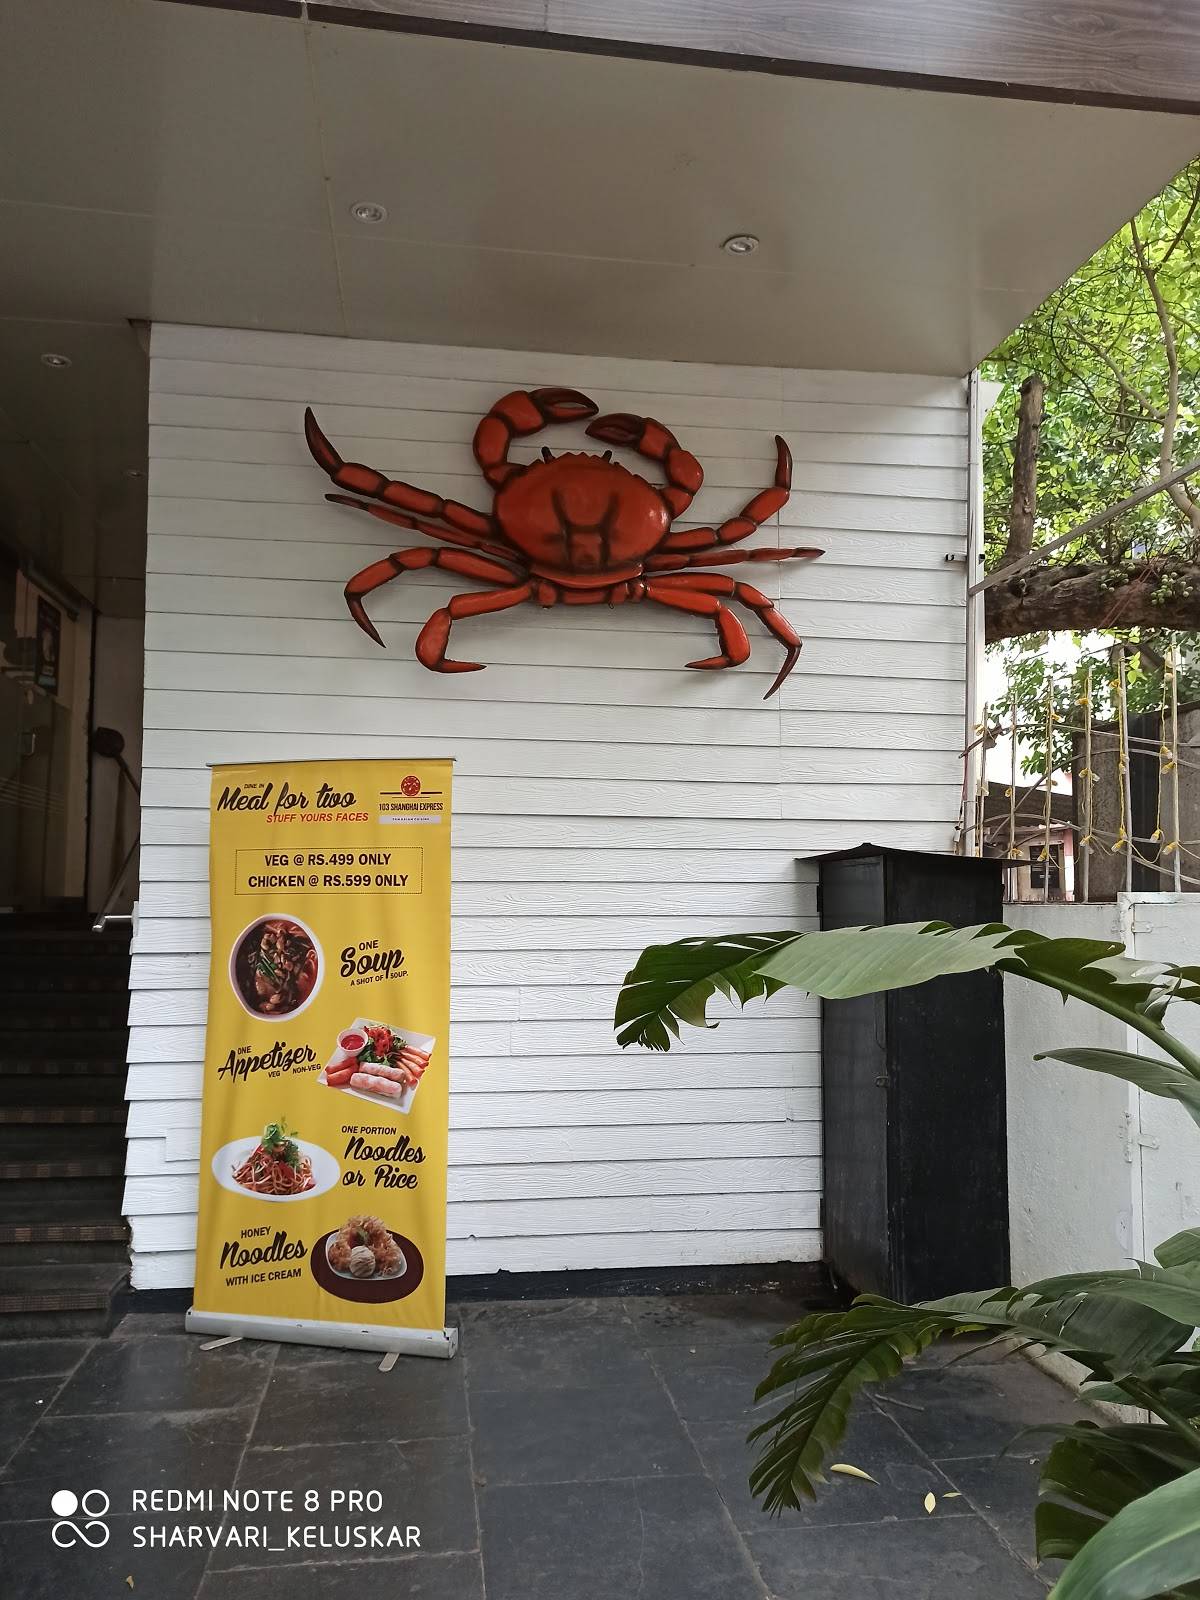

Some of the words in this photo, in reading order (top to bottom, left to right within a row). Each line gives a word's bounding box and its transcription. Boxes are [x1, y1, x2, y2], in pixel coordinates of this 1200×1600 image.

[217, 782, 273, 811] Meal
[273, 782, 309, 816] for
[316, 782, 357, 808] two
[379, 803, 390, 811] 103
[390, 803, 419, 811] SHANGHAI
[420, 802, 444, 811] EXPRESS
[266, 813, 297, 823] STUFF
[300, 812, 333, 822] YOURS
[335, 812, 369, 822] FACES
[265, 854, 289, 866] VEG
[293, 854, 305, 866] @
[307, 853, 354, 866] RS.499
[358, 853, 391, 866] ONLY
[248, 875, 305, 888] CHICKEN
[308, 874, 319, 887] @
[323, 874, 371, 887] RS.599
[375, 874, 409, 887] ONLY
[359, 940, 379, 951] ONE
[340, 946, 405, 979] Soup
[350, 979, 355, 987] A
[356, 976, 374, 986] SHOT
[375, 974, 384, 982] OF
[237, 1045, 252, 1055] ONE
[217, 1041, 317, 1083] Appetizer
[268, 1070, 281, 1078] VEG
[292, 1063, 322, 1075] NON-VEG
[341, 1125, 359, 1134] ONE
[360, 1126, 397, 1135] PORTION
[344, 1134, 426, 1163] Noodles
[342, 1169, 366, 1187] or
[374, 1164, 418, 1189] Rice
[241, 1225, 271, 1239] HONEY
[219, 1230, 308, 1269] Noodles
[226, 1275, 249, 1287] WITH
[251, 1272, 266, 1284] ICE
[268, 1268, 302, 1281] CREAM
